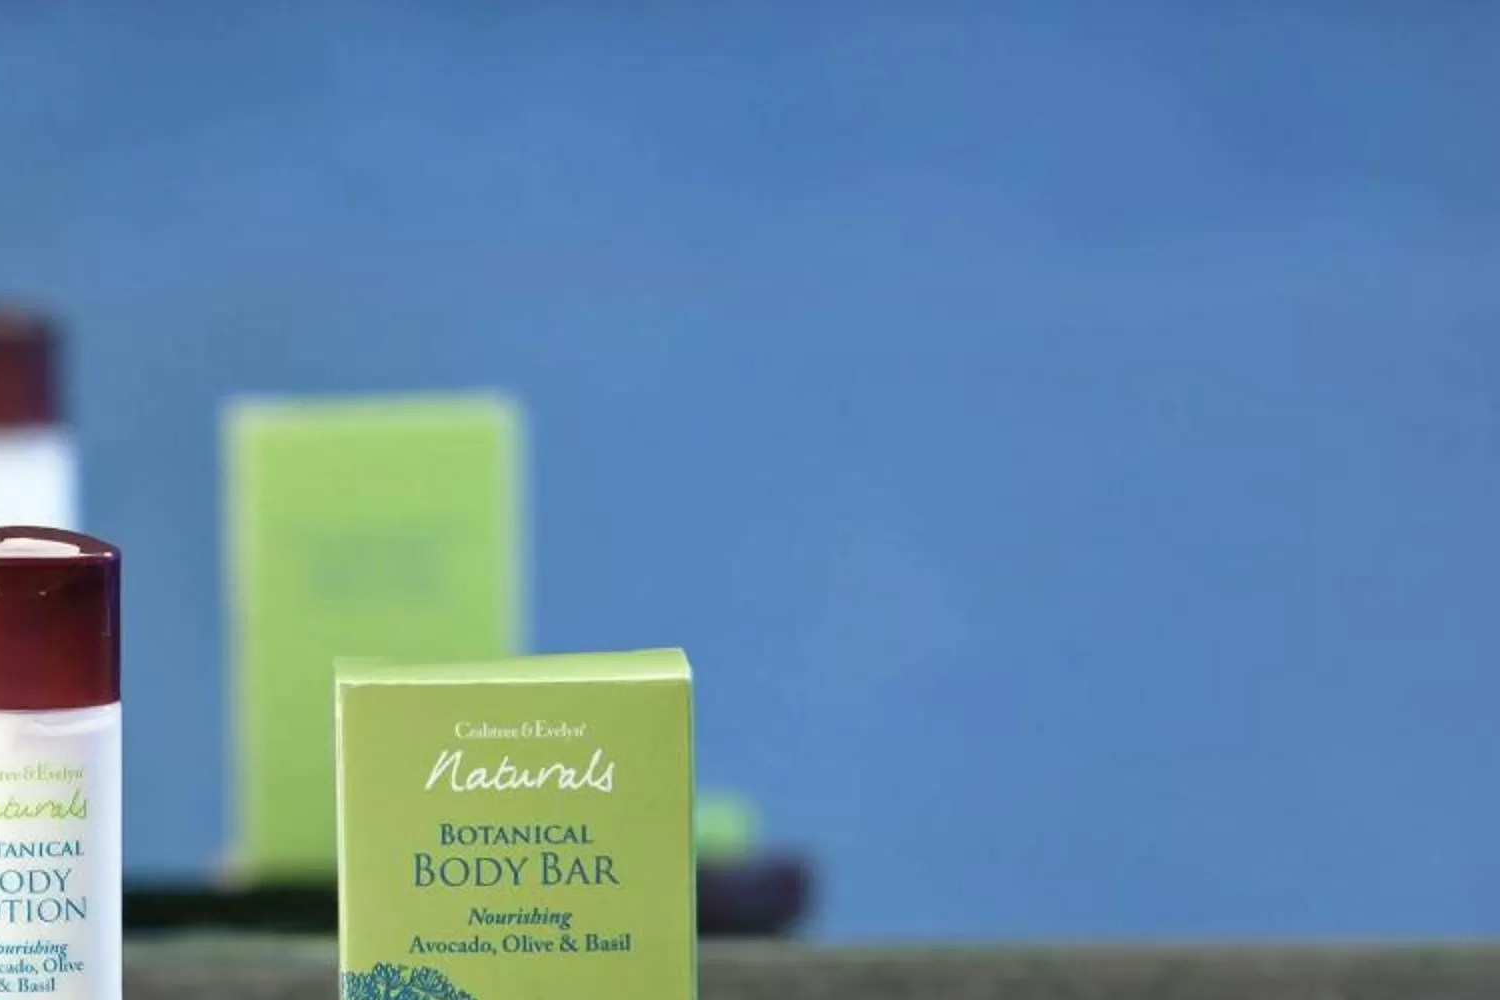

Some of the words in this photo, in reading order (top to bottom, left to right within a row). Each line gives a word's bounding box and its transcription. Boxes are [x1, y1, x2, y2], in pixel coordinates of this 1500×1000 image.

[521, 721, 533, 738] &
[536, 719, 584, 742] Evelyn
[424, 747, 615, 793] Naturals
[440, 823, 594, 846] BOTANICAL
[414, 851, 529, 888] BODY
[542, 851, 620, 886] BAR
[468, 907, 573, 930] Nourishing
[409, 935, 497, 956] Avocado,
[502, 934, 554, 953] Olive
[560, 936, 578, 953] &
[585, 933, 631, 952] Basil
[43, 955, 84, 974] Olive
[18, 976, 55, 993] Basil
